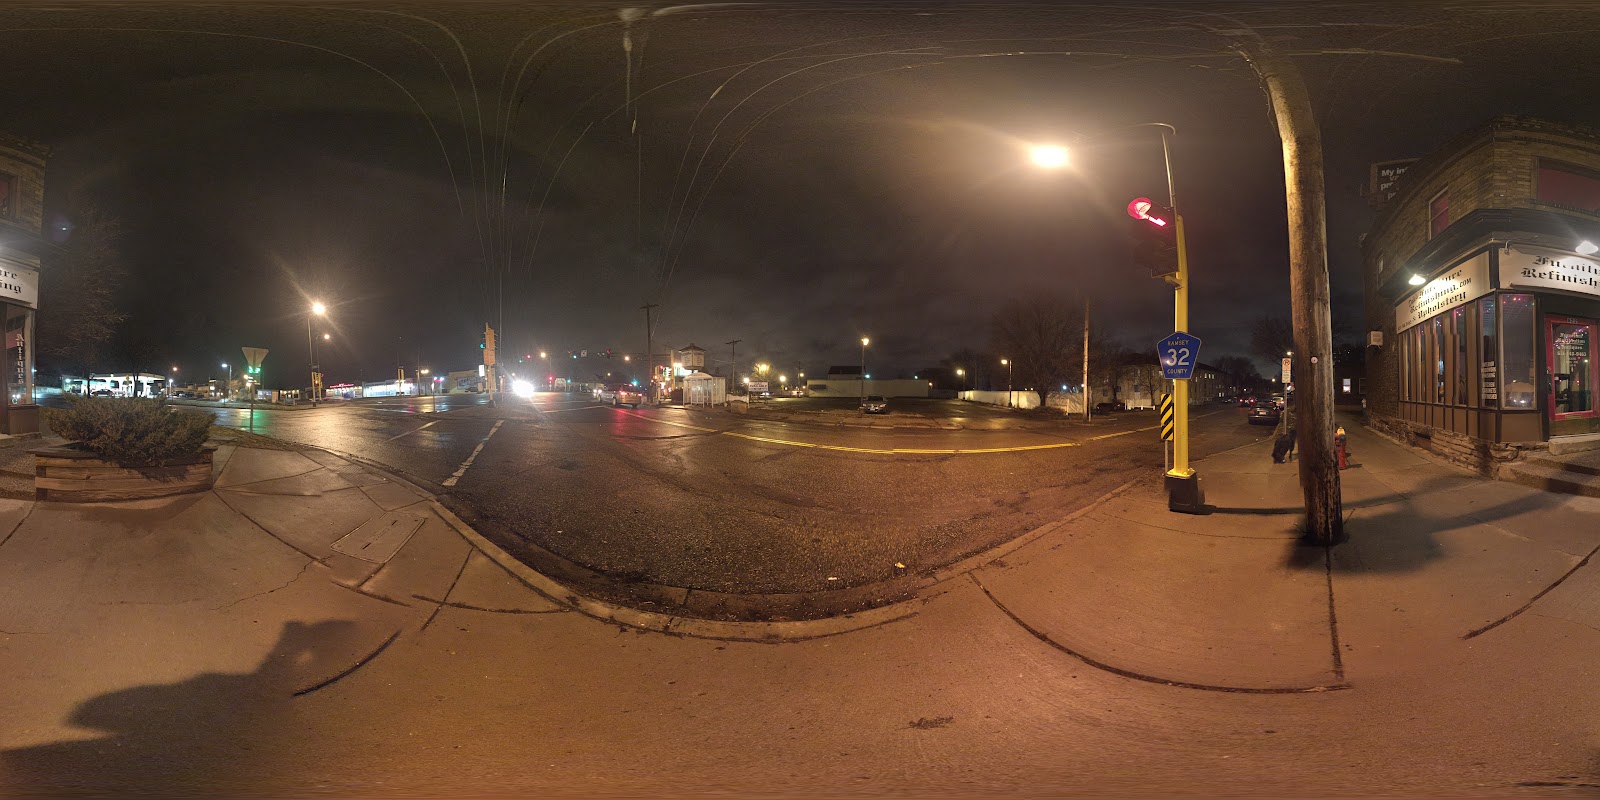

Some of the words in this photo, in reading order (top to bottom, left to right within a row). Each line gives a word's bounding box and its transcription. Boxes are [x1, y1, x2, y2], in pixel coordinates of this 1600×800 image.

[1381, 168, 1394, 177] My
[1418, 291, 1466, 319] Upholstery
[1166, 347, 1190, 367] 32
